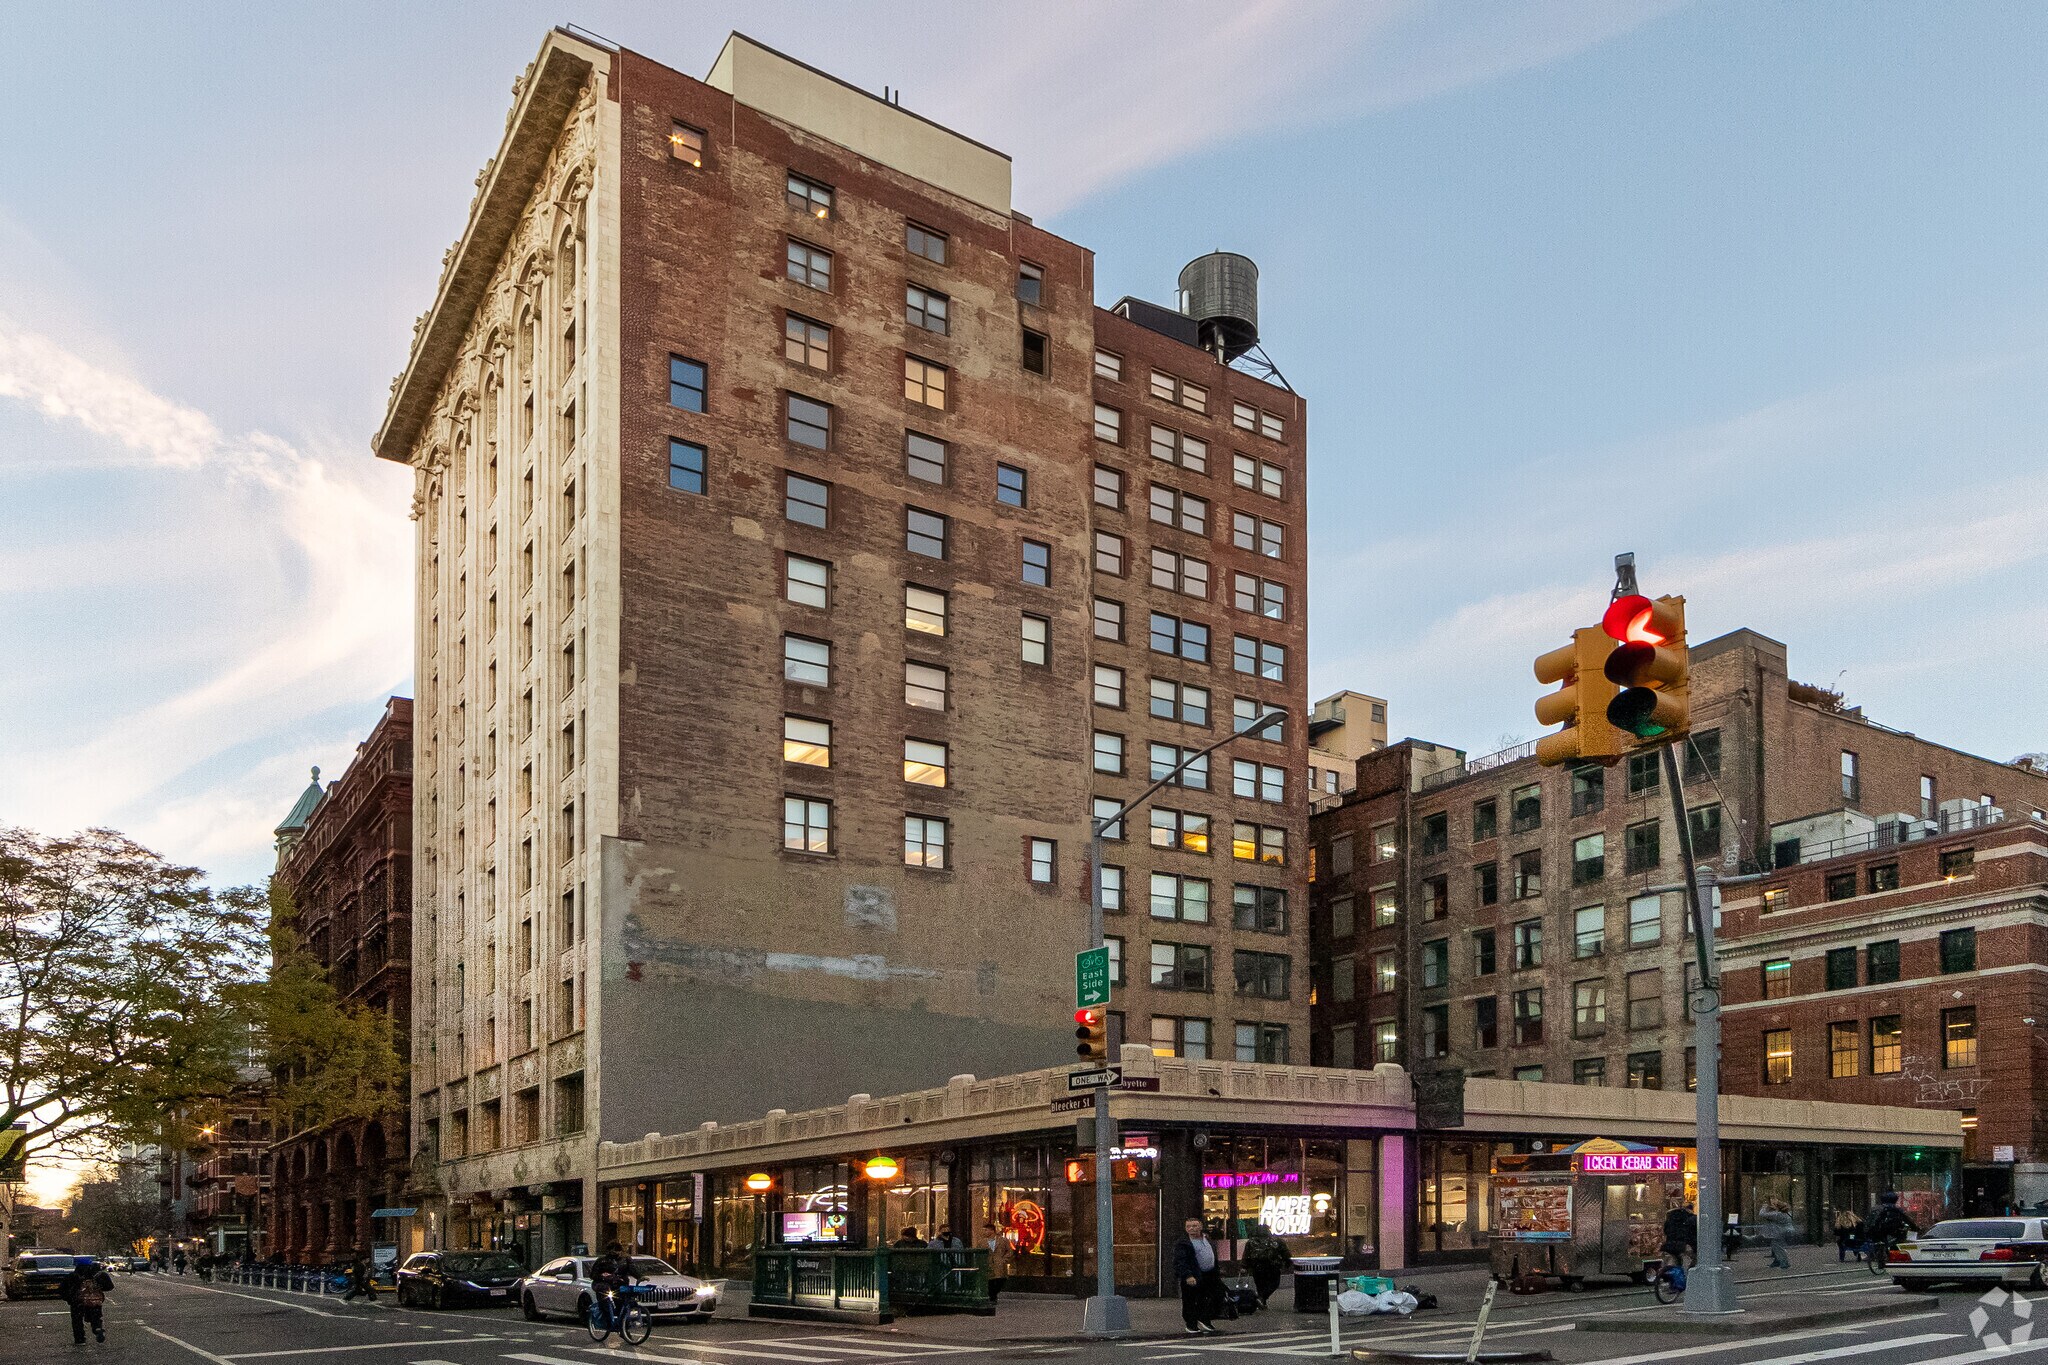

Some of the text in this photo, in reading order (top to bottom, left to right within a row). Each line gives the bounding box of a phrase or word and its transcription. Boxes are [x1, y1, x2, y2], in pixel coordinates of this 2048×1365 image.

[1082, 969, 1103, 980] East
[1082, 979, 1103, 990] Side
[1075, 1073, 1114, 1085] ONE WAY
[1051, 1097, 1090, 1112] Bleecker St
[1621, 1156, 1652, 1169] KEBAB
[1262, 1195, 1311, 1215] AAPE
[796, 1259, 819, 1269] Subway
